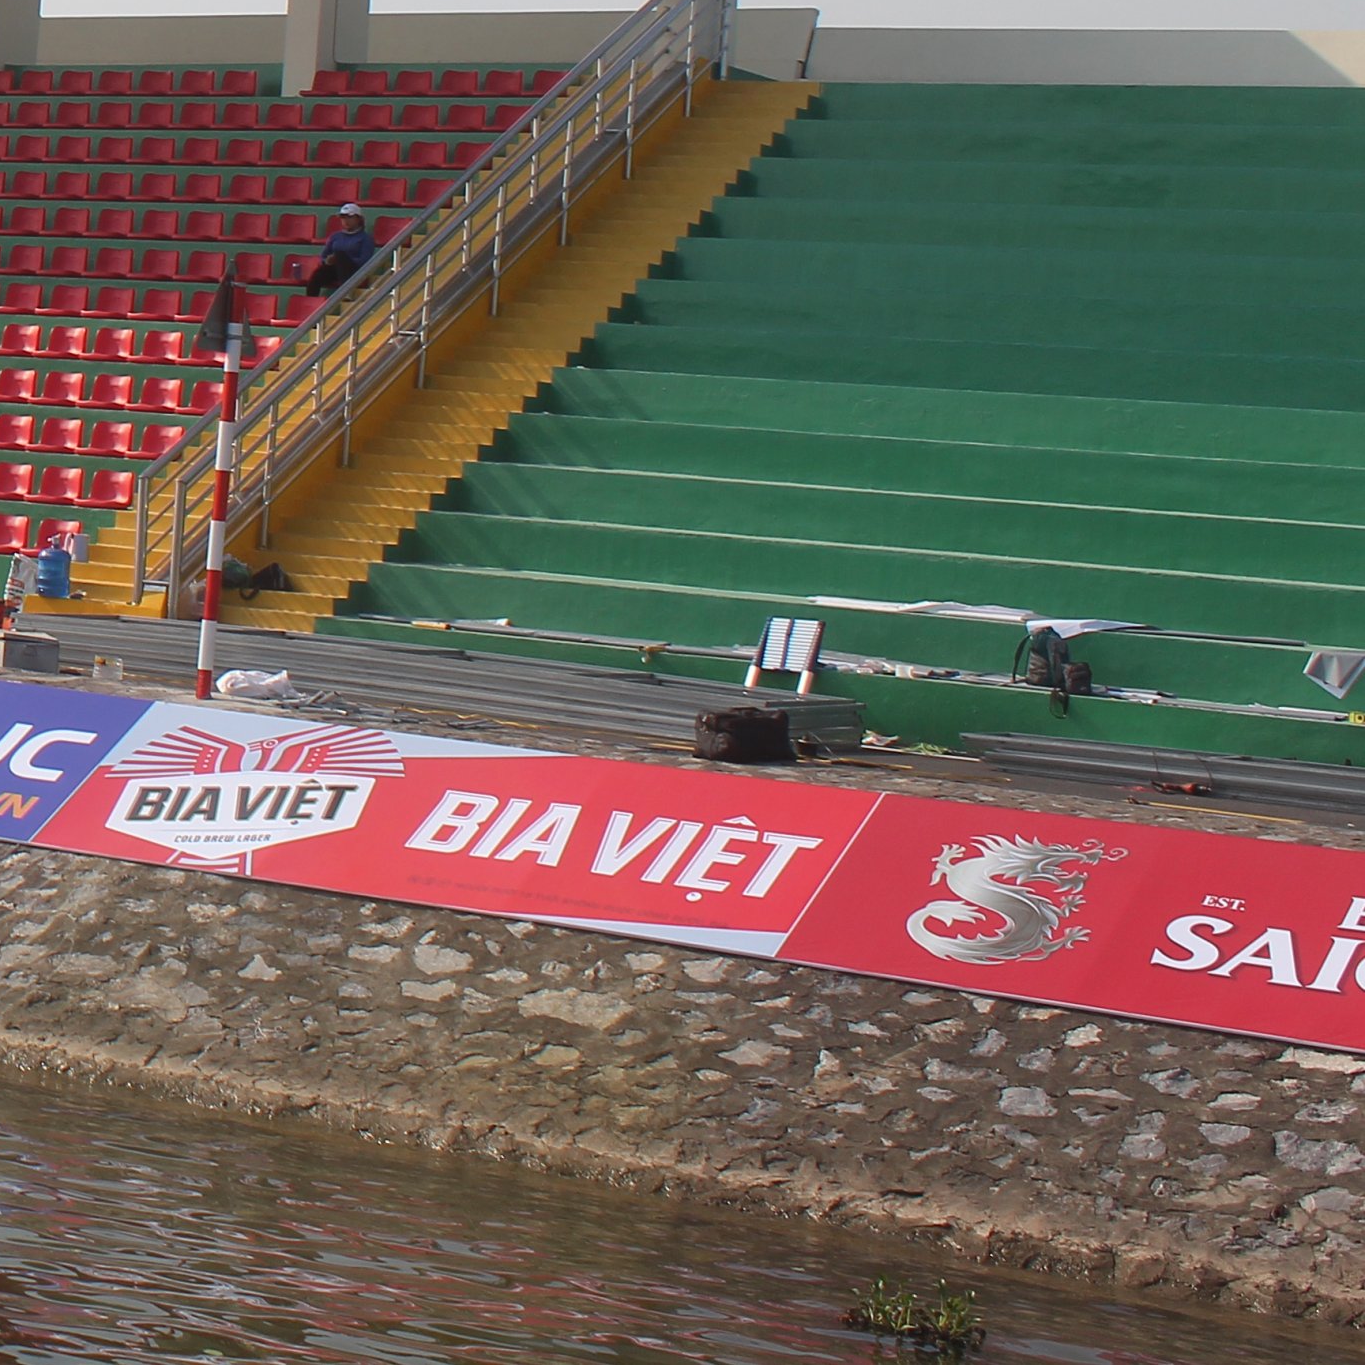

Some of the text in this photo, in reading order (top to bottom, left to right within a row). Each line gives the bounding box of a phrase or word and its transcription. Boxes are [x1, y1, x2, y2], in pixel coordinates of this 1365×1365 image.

[124, 777, 359, 826] BIA VIỆT
[174, 833, 272, 844] COLD BREW LAGER
[403, 789, 582, 868] BIA
[590, 810, 824, 902] VIỆT
[1200, 894, 1246, 912] EST.
[1150, 914, 1365, 993] SAI
